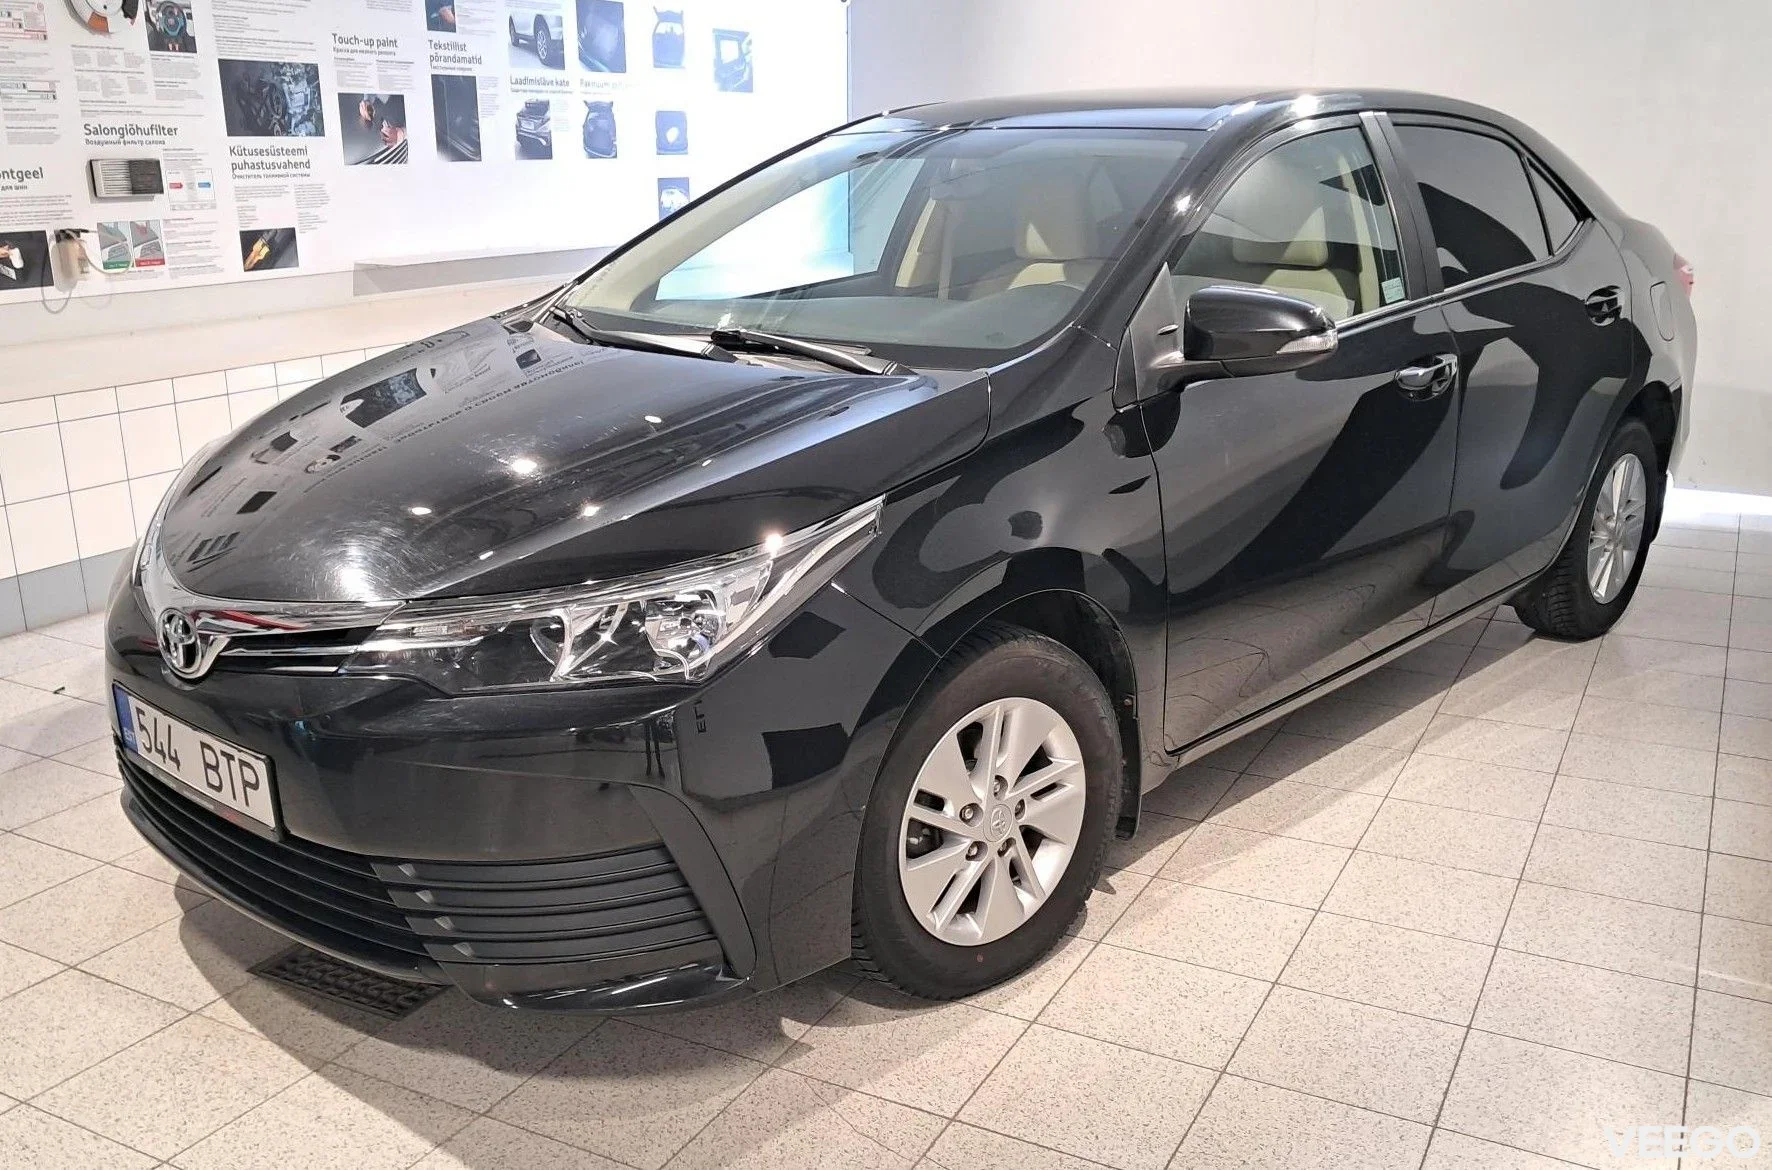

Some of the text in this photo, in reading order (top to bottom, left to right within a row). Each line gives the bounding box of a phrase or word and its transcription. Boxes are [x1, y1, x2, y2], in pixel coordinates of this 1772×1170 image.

[332, 33, 374, 48] Touch-up
[376, 37, 398, 49] paint
[428, 40, 467, 52] Tekstillist
[430, 52, 482, 65] põrandamatid
[555, 78, 570, 87] kate
[83, 123, 178, 140] Salongiõhufilter
[229, 145, 308, 157] Kütusesüsteemi
[231, 158, 311, 173] puhastusvahend
[0, 167, 44, 183] ntgeel
[136, 706, 181, 772] 544
[200, 740, 260, 807] BTP
